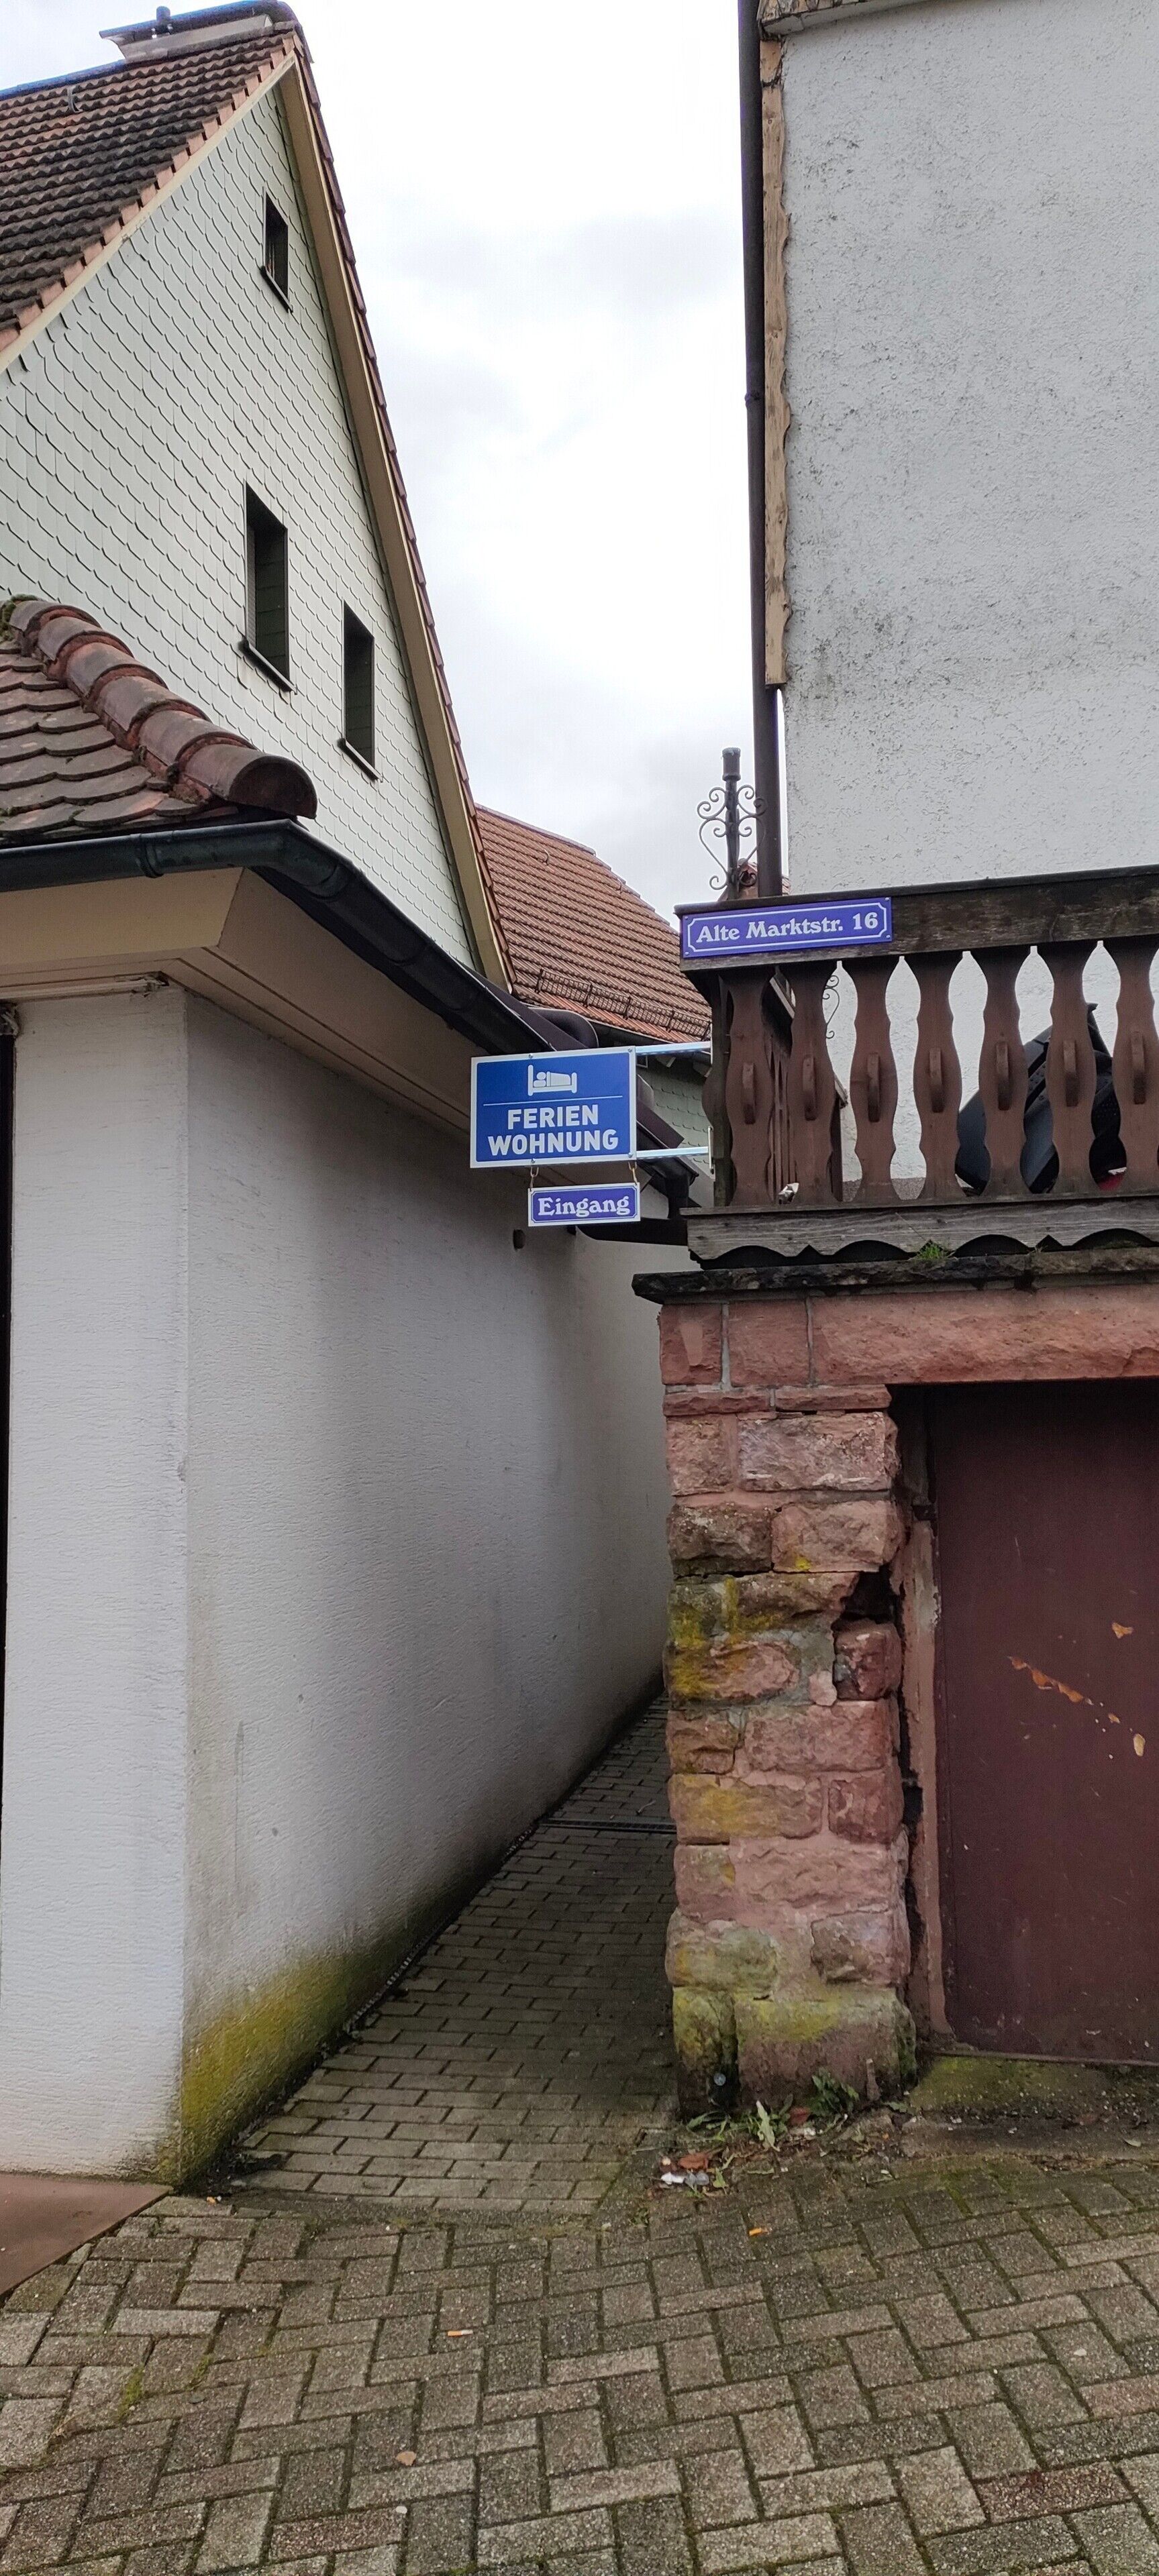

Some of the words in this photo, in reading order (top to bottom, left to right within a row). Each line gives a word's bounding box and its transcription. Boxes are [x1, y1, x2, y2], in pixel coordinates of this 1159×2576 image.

[695, 924, 740, 943] Alte
[746, 917, 844, 939] Marktstr.
[852, 912, 878, 930] 16
[507, 1104, 599, 1130] FERIEN
[487, 1129, 619, 1156] WOHNUNG
[538, 1195, 631, 1218] Eingang
